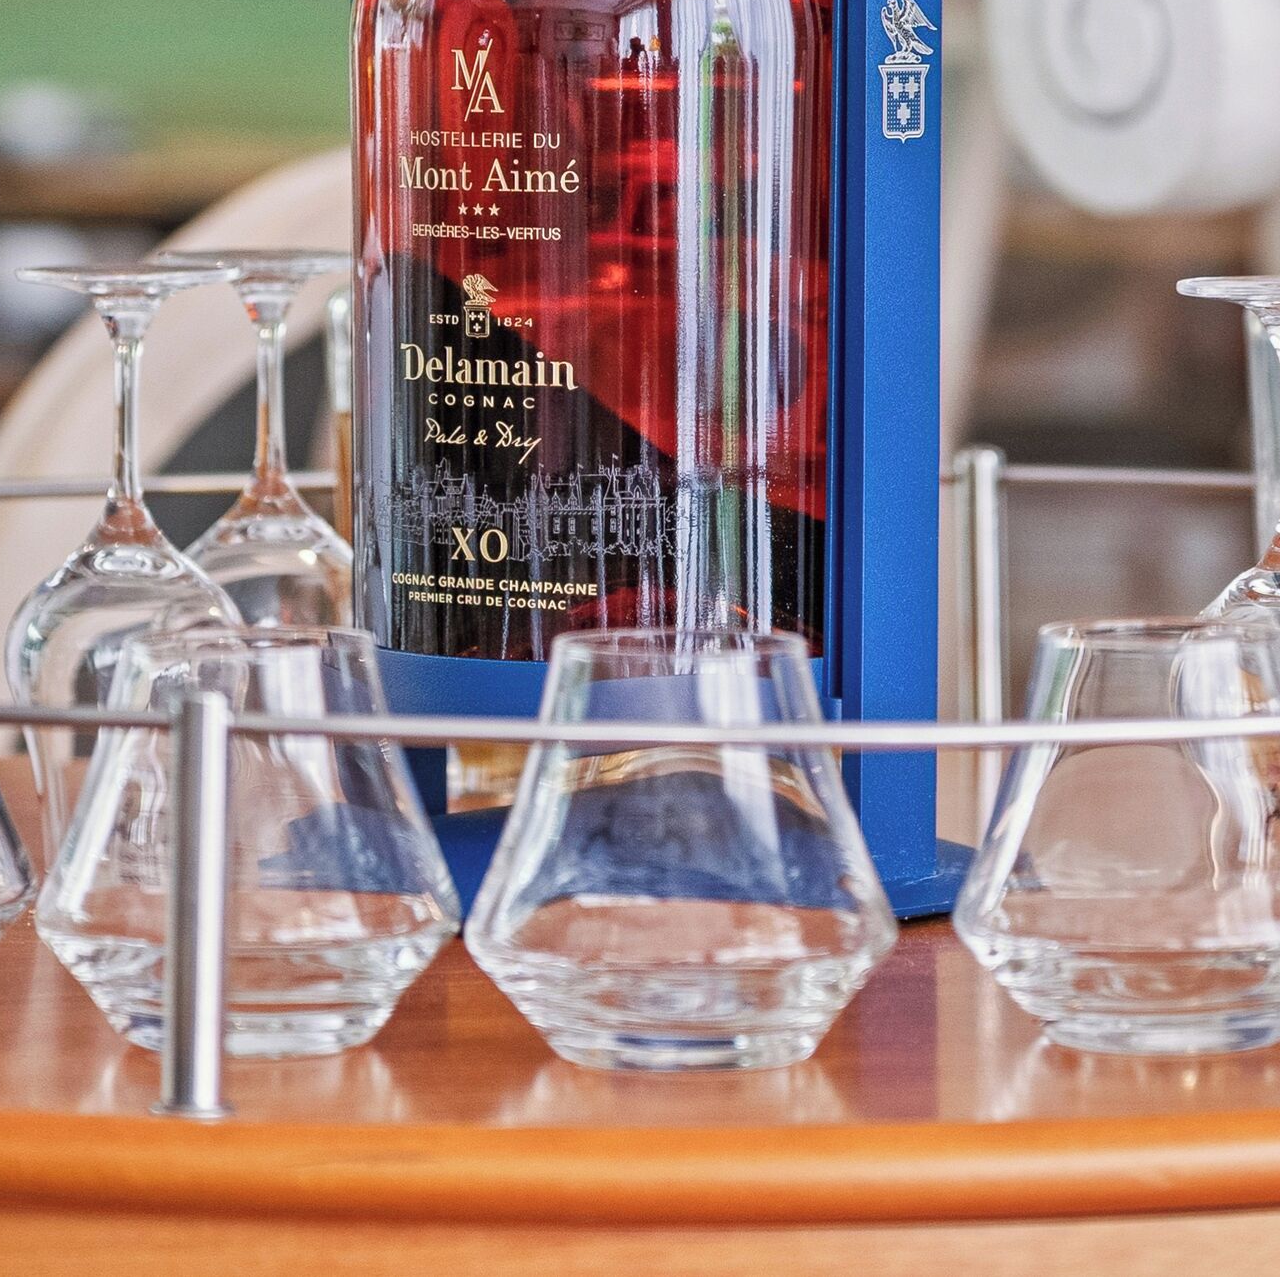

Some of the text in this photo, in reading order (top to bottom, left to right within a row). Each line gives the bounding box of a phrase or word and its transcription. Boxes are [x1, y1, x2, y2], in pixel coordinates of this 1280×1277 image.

[409, 130, 561, 149] HOSTELLERIE DU
[398, 156, 580, 194] Mont Aimé
[411, 221, 561, 241] BERGÈRES-LES-VERTUS
[429, 313, 533, 328] ESTD 1824
[400, 342, 579, 390] Delamain
[427, 393, 536, 409] COGNAC
[424, 418, 542, 465] Pale & Dry
[450, 527, 509, 563] XO
[391, 572, 598, 597] COGNAC GRANDE CHAMPAGNE
[408, 590, 567, 611] PREMIER CRU DE COGNAC
